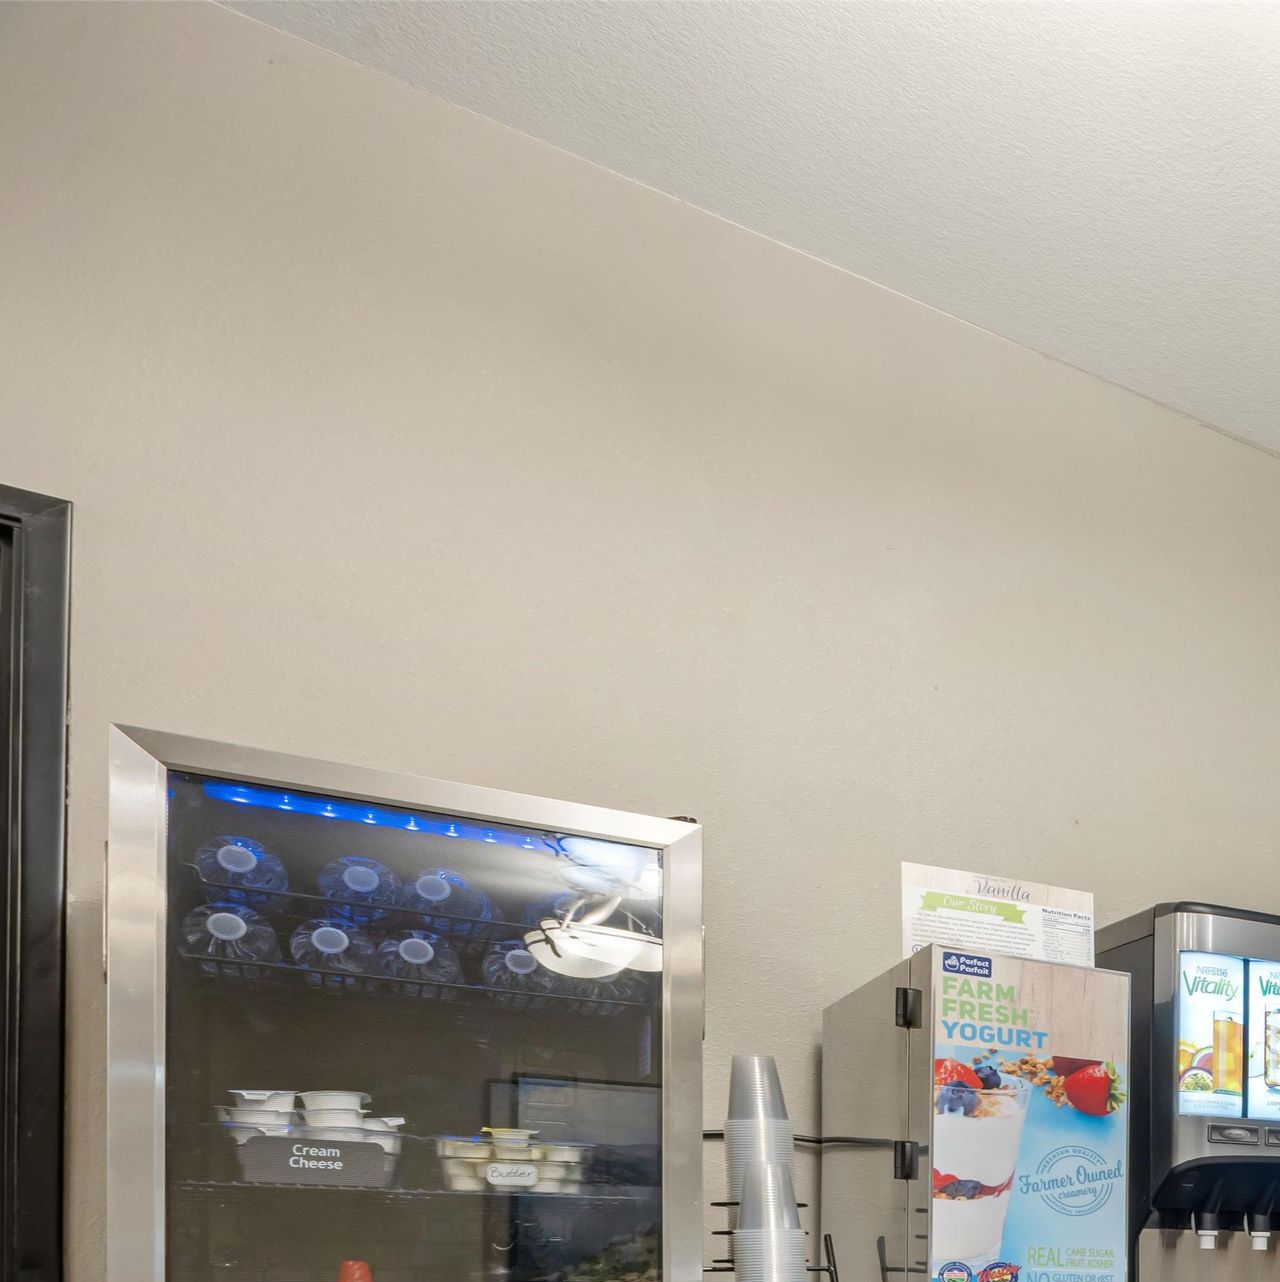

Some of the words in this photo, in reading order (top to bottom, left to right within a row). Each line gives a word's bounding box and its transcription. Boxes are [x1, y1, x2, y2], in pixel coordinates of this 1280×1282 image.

[976, 880, 1031, 902] Vanilla
[943, 896, 963, 907] Our
[967, 899, 997, 914] Story
[1042, 908, 1072, 918] Nutrition
[1073, 913, 1091, 921] Facts
[960, 956, 990, 968] Perfect
[960, 964, 990, 976] Parfait
[942, 976, 1016, 1004] FARM
[942, 999, 1029, 1027] FRESH
[941, 1020, 1049, 1049] YOGURT
[292, 1144, 341, 1157] Cream
[289, 1157, 343, 1170] Cheese
[489, 1166, 536, 1180] Butter
[1019, 1173, 1075, 1195] Farmer
[1076, 1160, 1125, 1185] Owned
[1058, 1186, 1098, 1200] creamery
[1027, 1247, 1065, 1267] REAL
[1066, 1248, 1087, 1257] CANE
